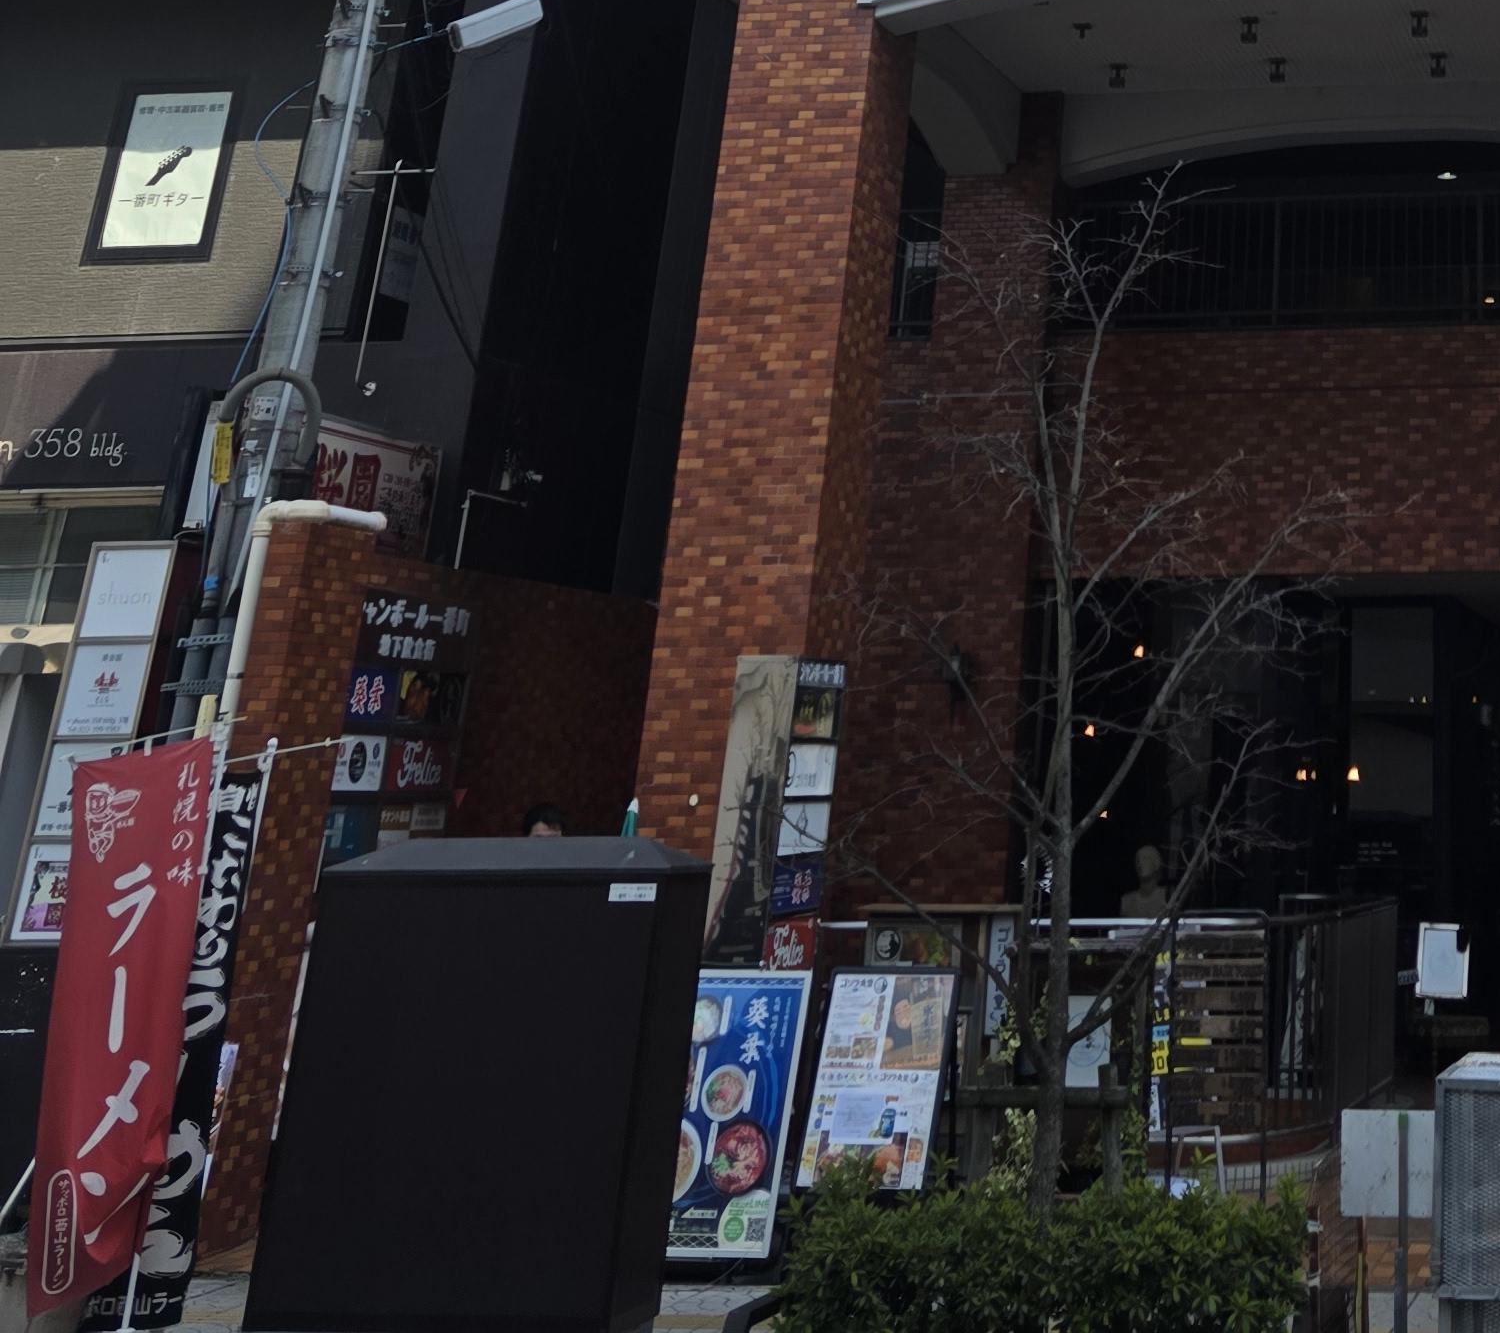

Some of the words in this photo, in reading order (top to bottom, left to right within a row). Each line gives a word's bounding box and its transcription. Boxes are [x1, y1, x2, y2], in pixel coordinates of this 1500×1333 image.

[118, 191, 204, 208] 一番町ギター
[24, 427, 83, 458] 358
[90, 432, 128, 467] bldg.
[97, 580, 151, 606] shuon
[166, 761, 200, 887] 札幌の味
[77, 861, 157, 1246] ラーメン
[53, 1179, 70, 1290] サッポロ西山ラーメン
